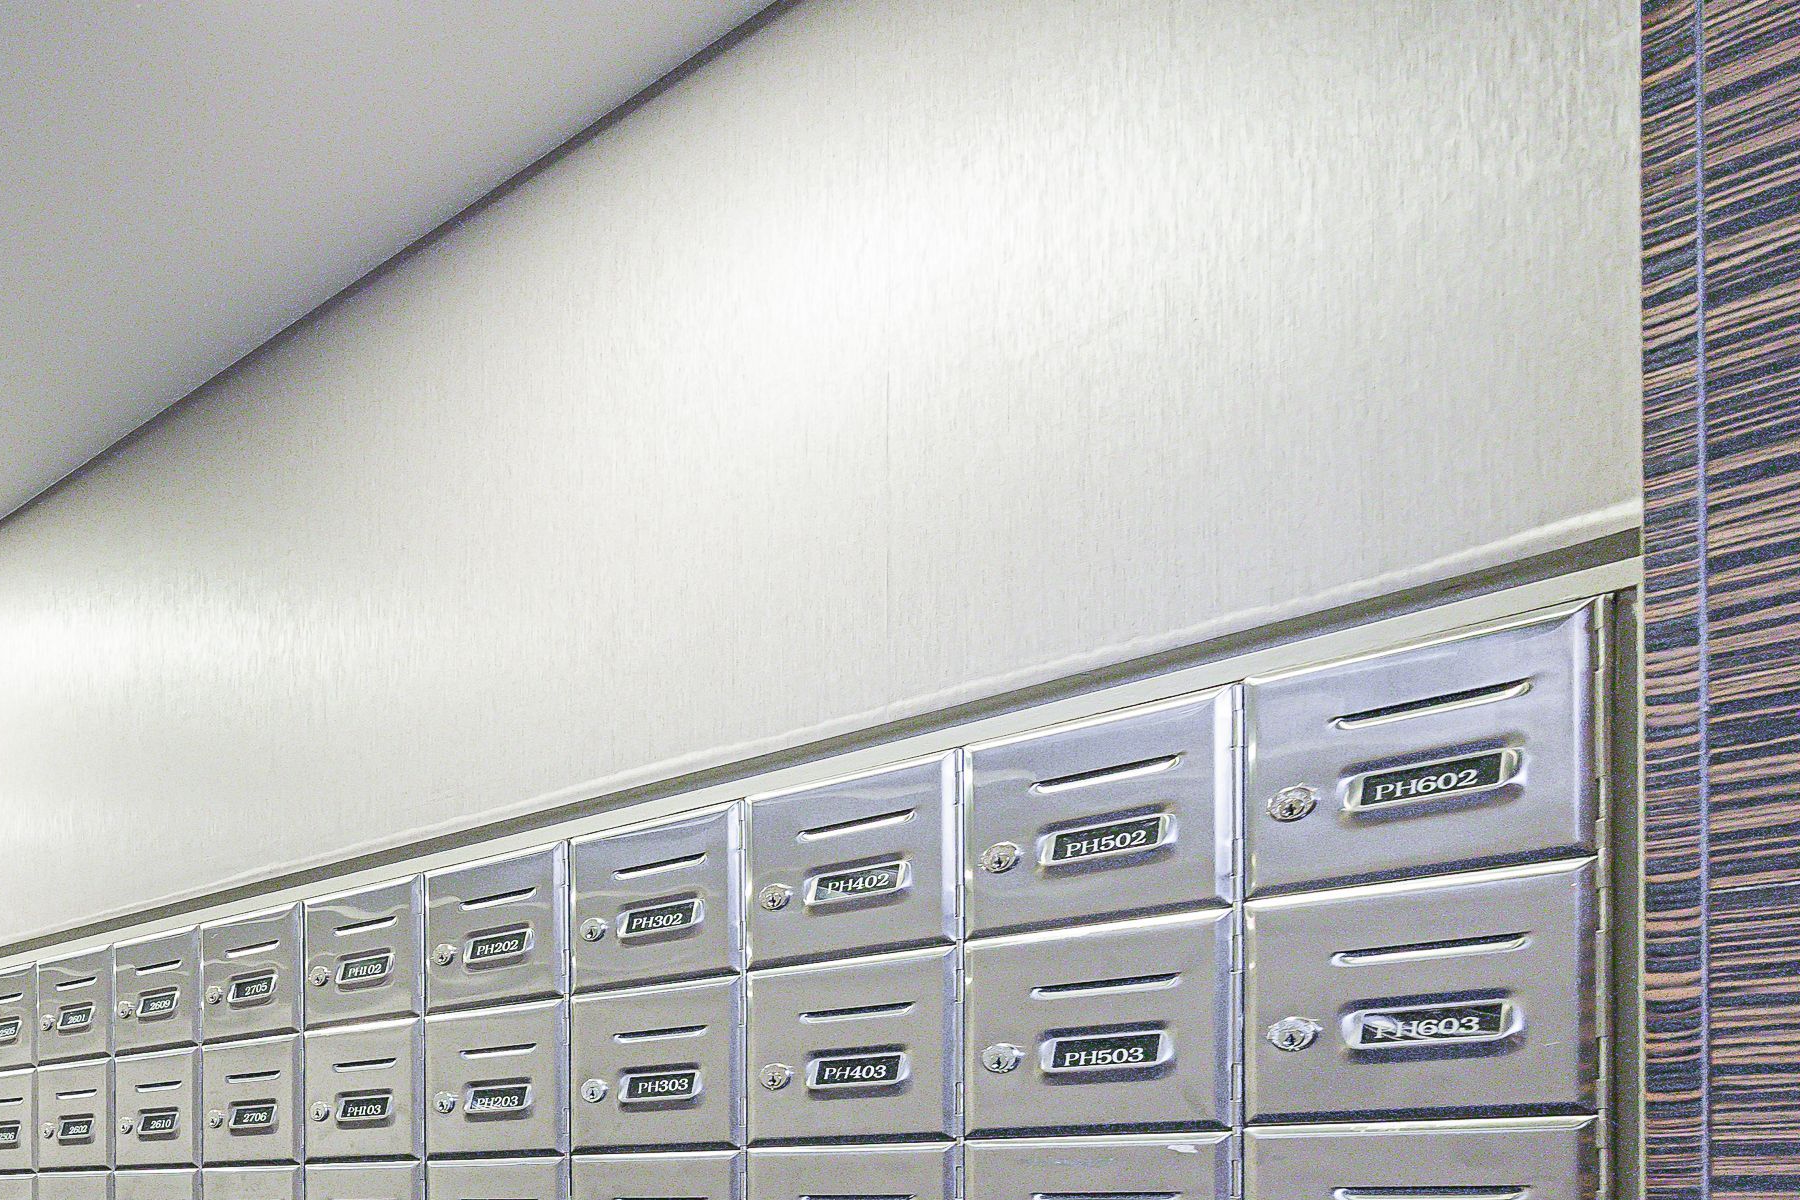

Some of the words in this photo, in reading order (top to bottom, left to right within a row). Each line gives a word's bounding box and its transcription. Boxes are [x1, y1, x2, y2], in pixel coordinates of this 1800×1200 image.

[1375, 769, 1479, 801] PH602
[1065, 830, 1147, 858] PH502
[827, 873, 889, 895] PH402
[631, 912, 682, 930] PH302
[476, 939, 519, 955] PH202
[347, 964, 382, 977] PH102
[245, 983, 268, 996] 2705
[149, 999, 171, 1010] 2609
[67, 1014, 86, 1025] 2601
[1375, 1016, 1480, 1039] PH603
[1064, 1046, 1144, 1066] PH503
[823, 1064, 887, 1080] PH403
[637, 1078, 689, 1094] PH303
[477, 1096, 519, 1108] PH203
[347, 1104, 382, 1116] PH103
[150, 1119, 171, 1129] 2610
[243, 1112, 268, 1123] 2706
[68, 1125, 88, 1135] 2602
